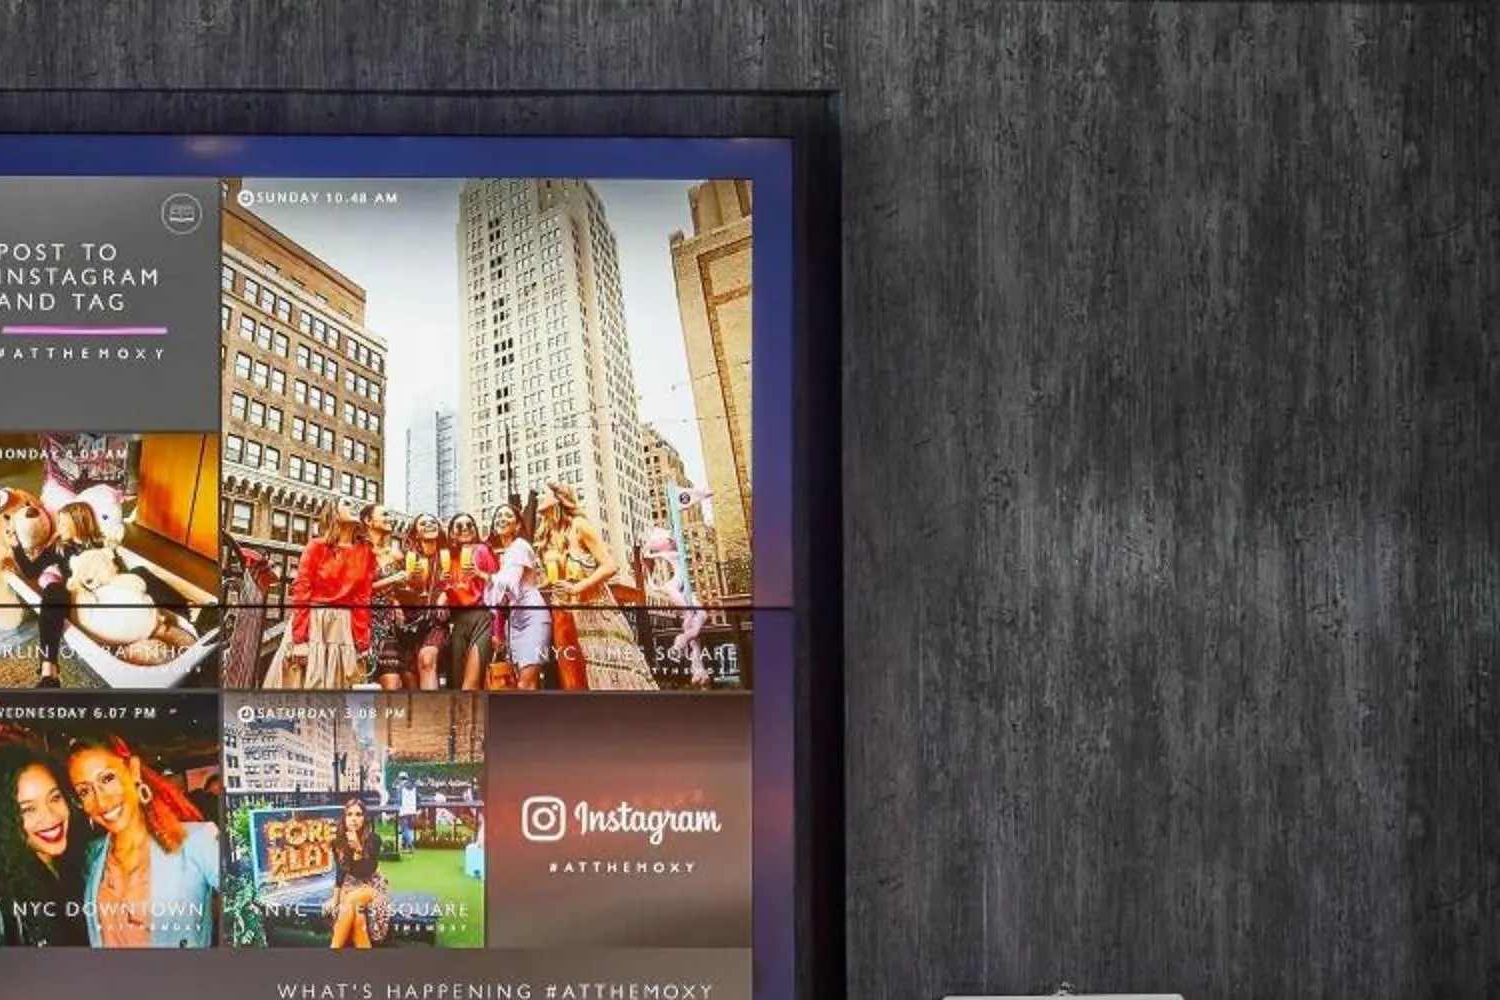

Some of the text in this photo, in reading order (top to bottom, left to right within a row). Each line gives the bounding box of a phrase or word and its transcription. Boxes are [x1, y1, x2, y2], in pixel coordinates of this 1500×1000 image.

[257, 191, 398, 204] SUNDAY 10.48 AM
[81, 243, 118, 261] TO
[74, 293, 126, 311] TAG
[93, 707, 127, 719] 6.07
[134, 707, 156, 719] PM
[256, 707, 337, 720] SATURDAY
[385, 707, 406, 719] PM
[574, 800, 722, 845] Instagram
[267, 844, 334, 879] PLA
[549, 861, 696, 873] #ATTHEMOXY
[13, 901, 203, 917] NYC DOWNTOWN
[387, 902, 469, 918] SQUARE
[277, 983, 714, 1000] WHAT'S HAPPENING #ATTHEMOXY
